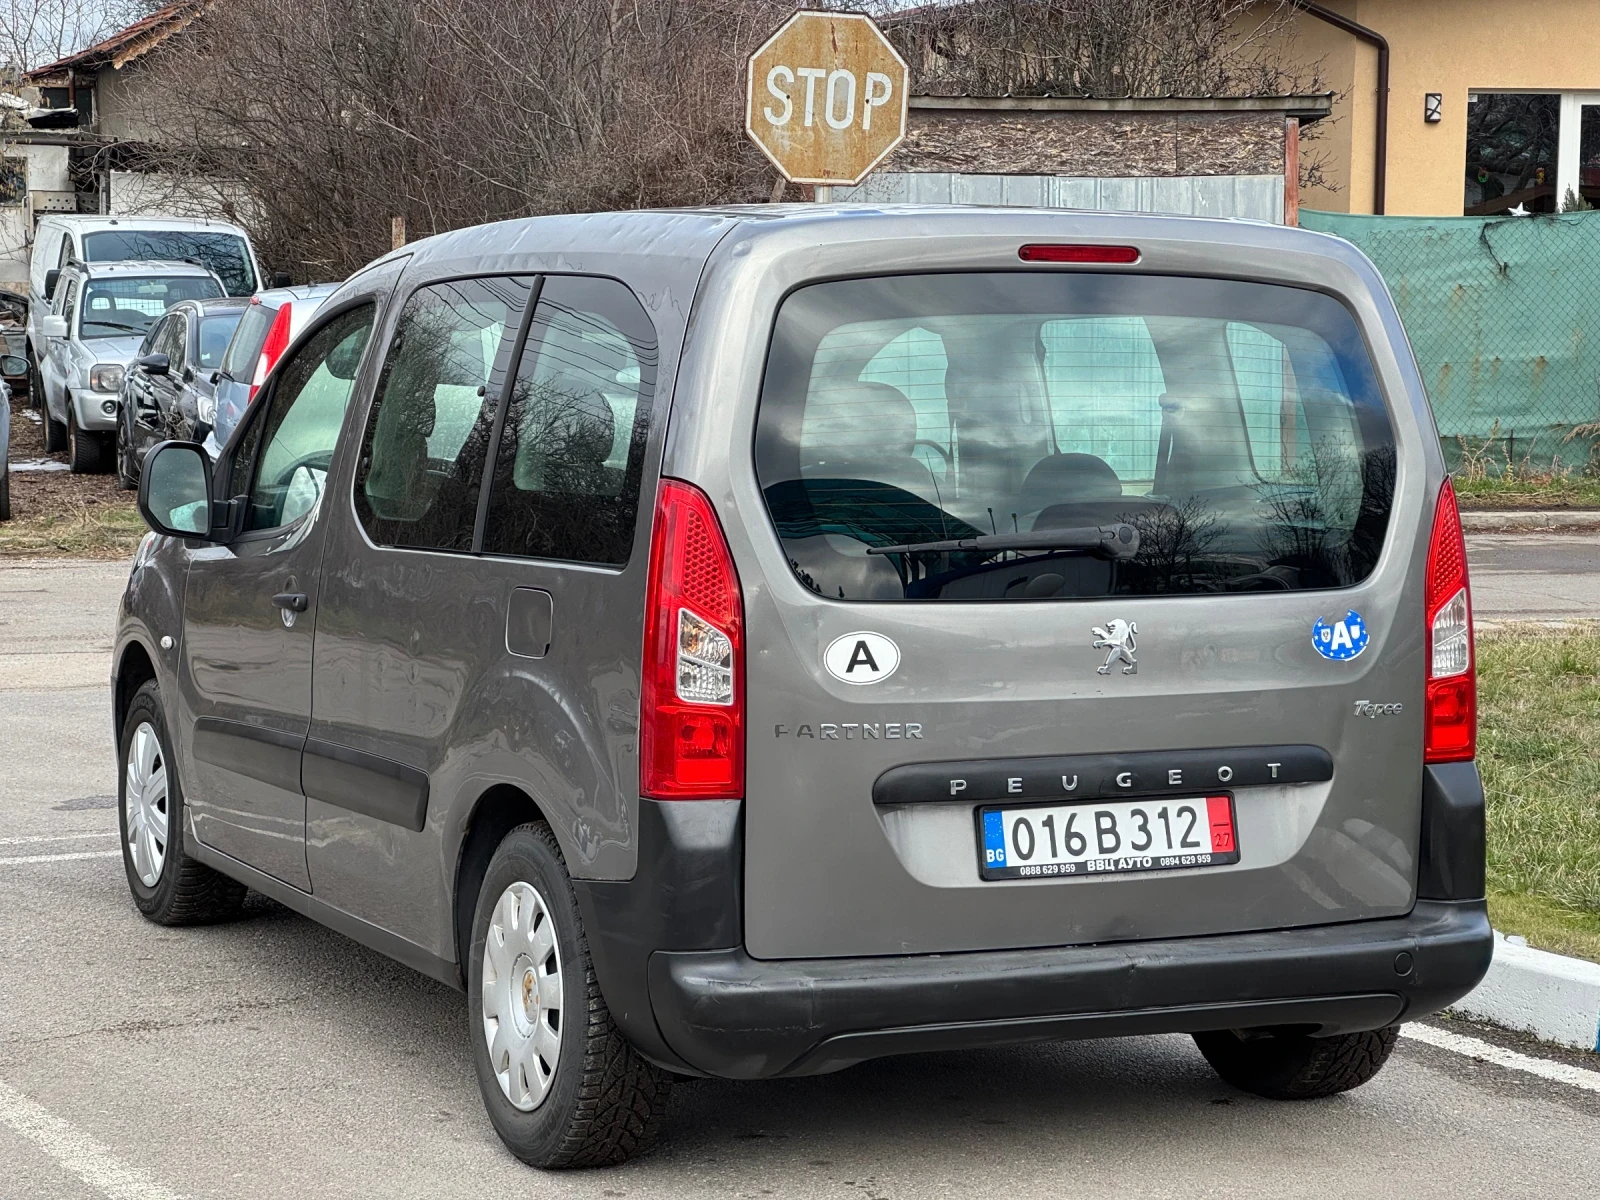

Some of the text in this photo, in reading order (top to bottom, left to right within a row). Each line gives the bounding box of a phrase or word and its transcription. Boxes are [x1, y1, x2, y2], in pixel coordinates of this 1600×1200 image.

[764, 65, 892, 130] STOP
[845, 640, 880, 673] A
[1353, 700, 1403, 719] Tepee
[949, 762, 1282, 796] PEUGEOT
[986, 848, 1005, 863] BG
[1020, 865, 1041, 876] 0888
[1042, 864, 1058, 875] 629
[1060, 863, 1076, 874] 959
[1160, 856, 1180, 867] 0894
[1181, 855, 1196, 866] 629
[1197, 853, 1212, 864] 959
